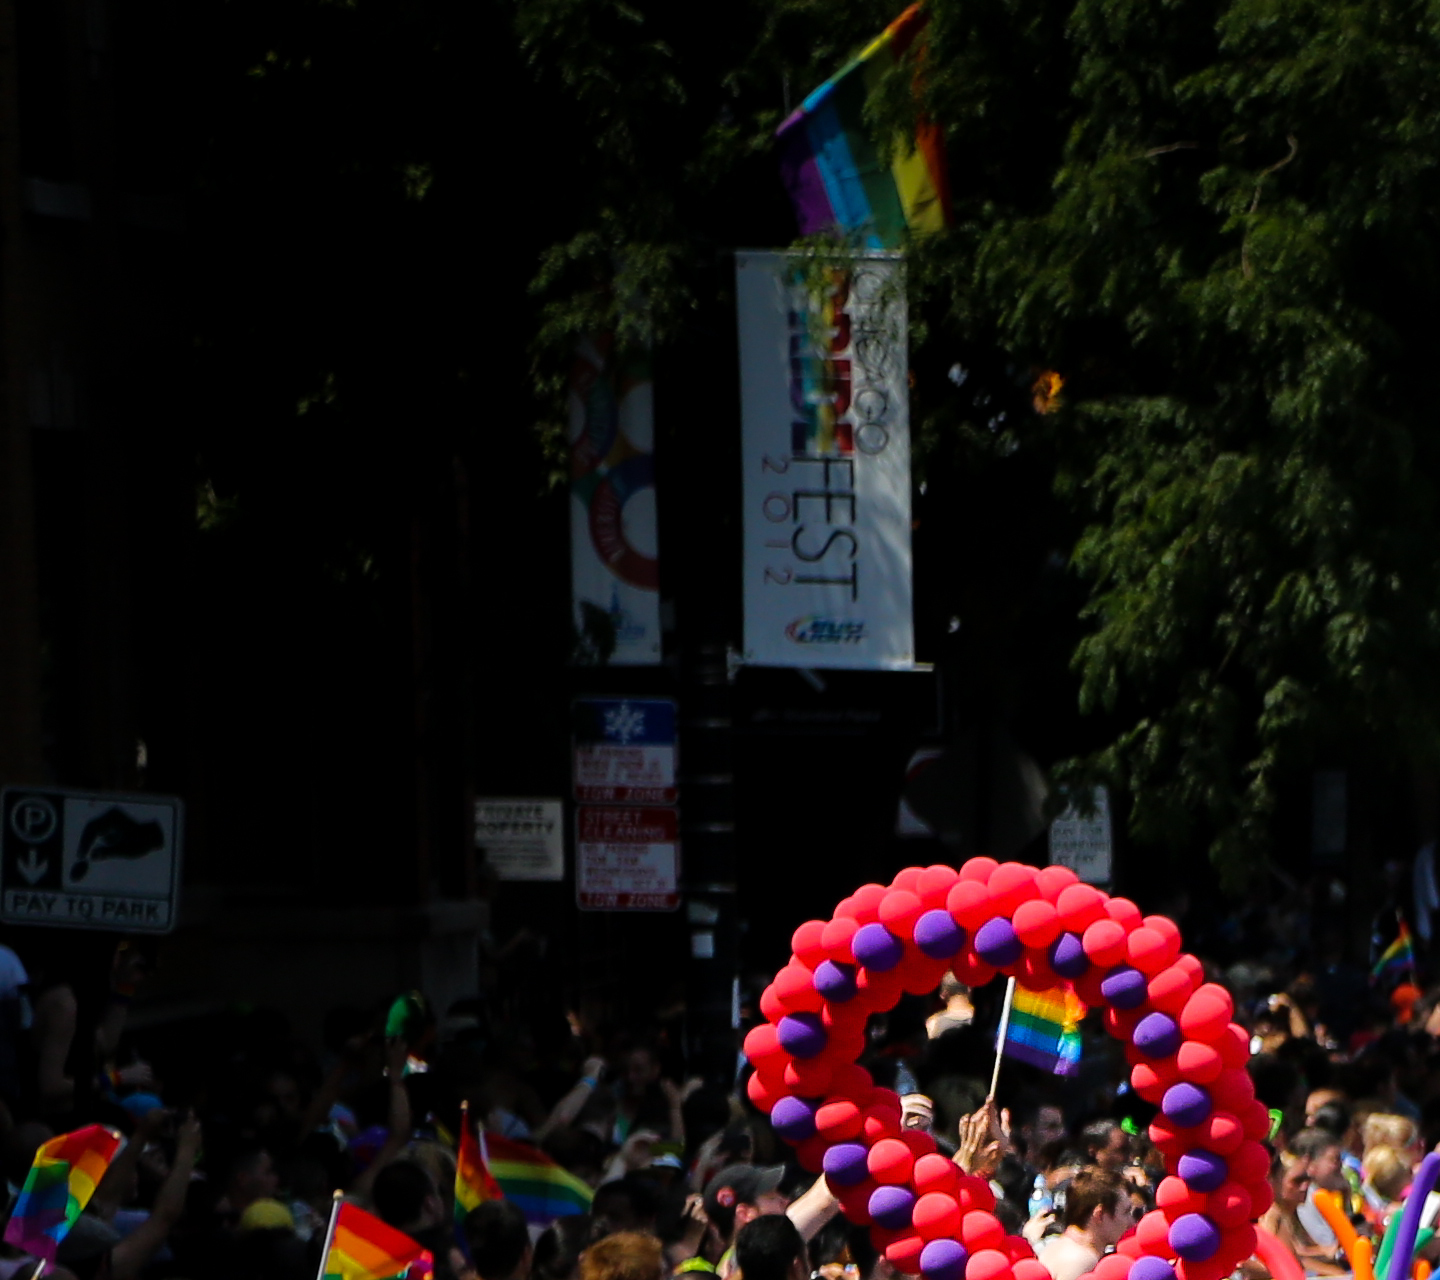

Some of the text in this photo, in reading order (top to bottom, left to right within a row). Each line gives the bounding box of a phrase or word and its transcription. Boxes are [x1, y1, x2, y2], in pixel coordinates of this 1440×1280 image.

[761, 454, 794, 586] 2012
[792, 457, 858, 603] FEST
[13, 894, 160, 921] PAY TO PARK
